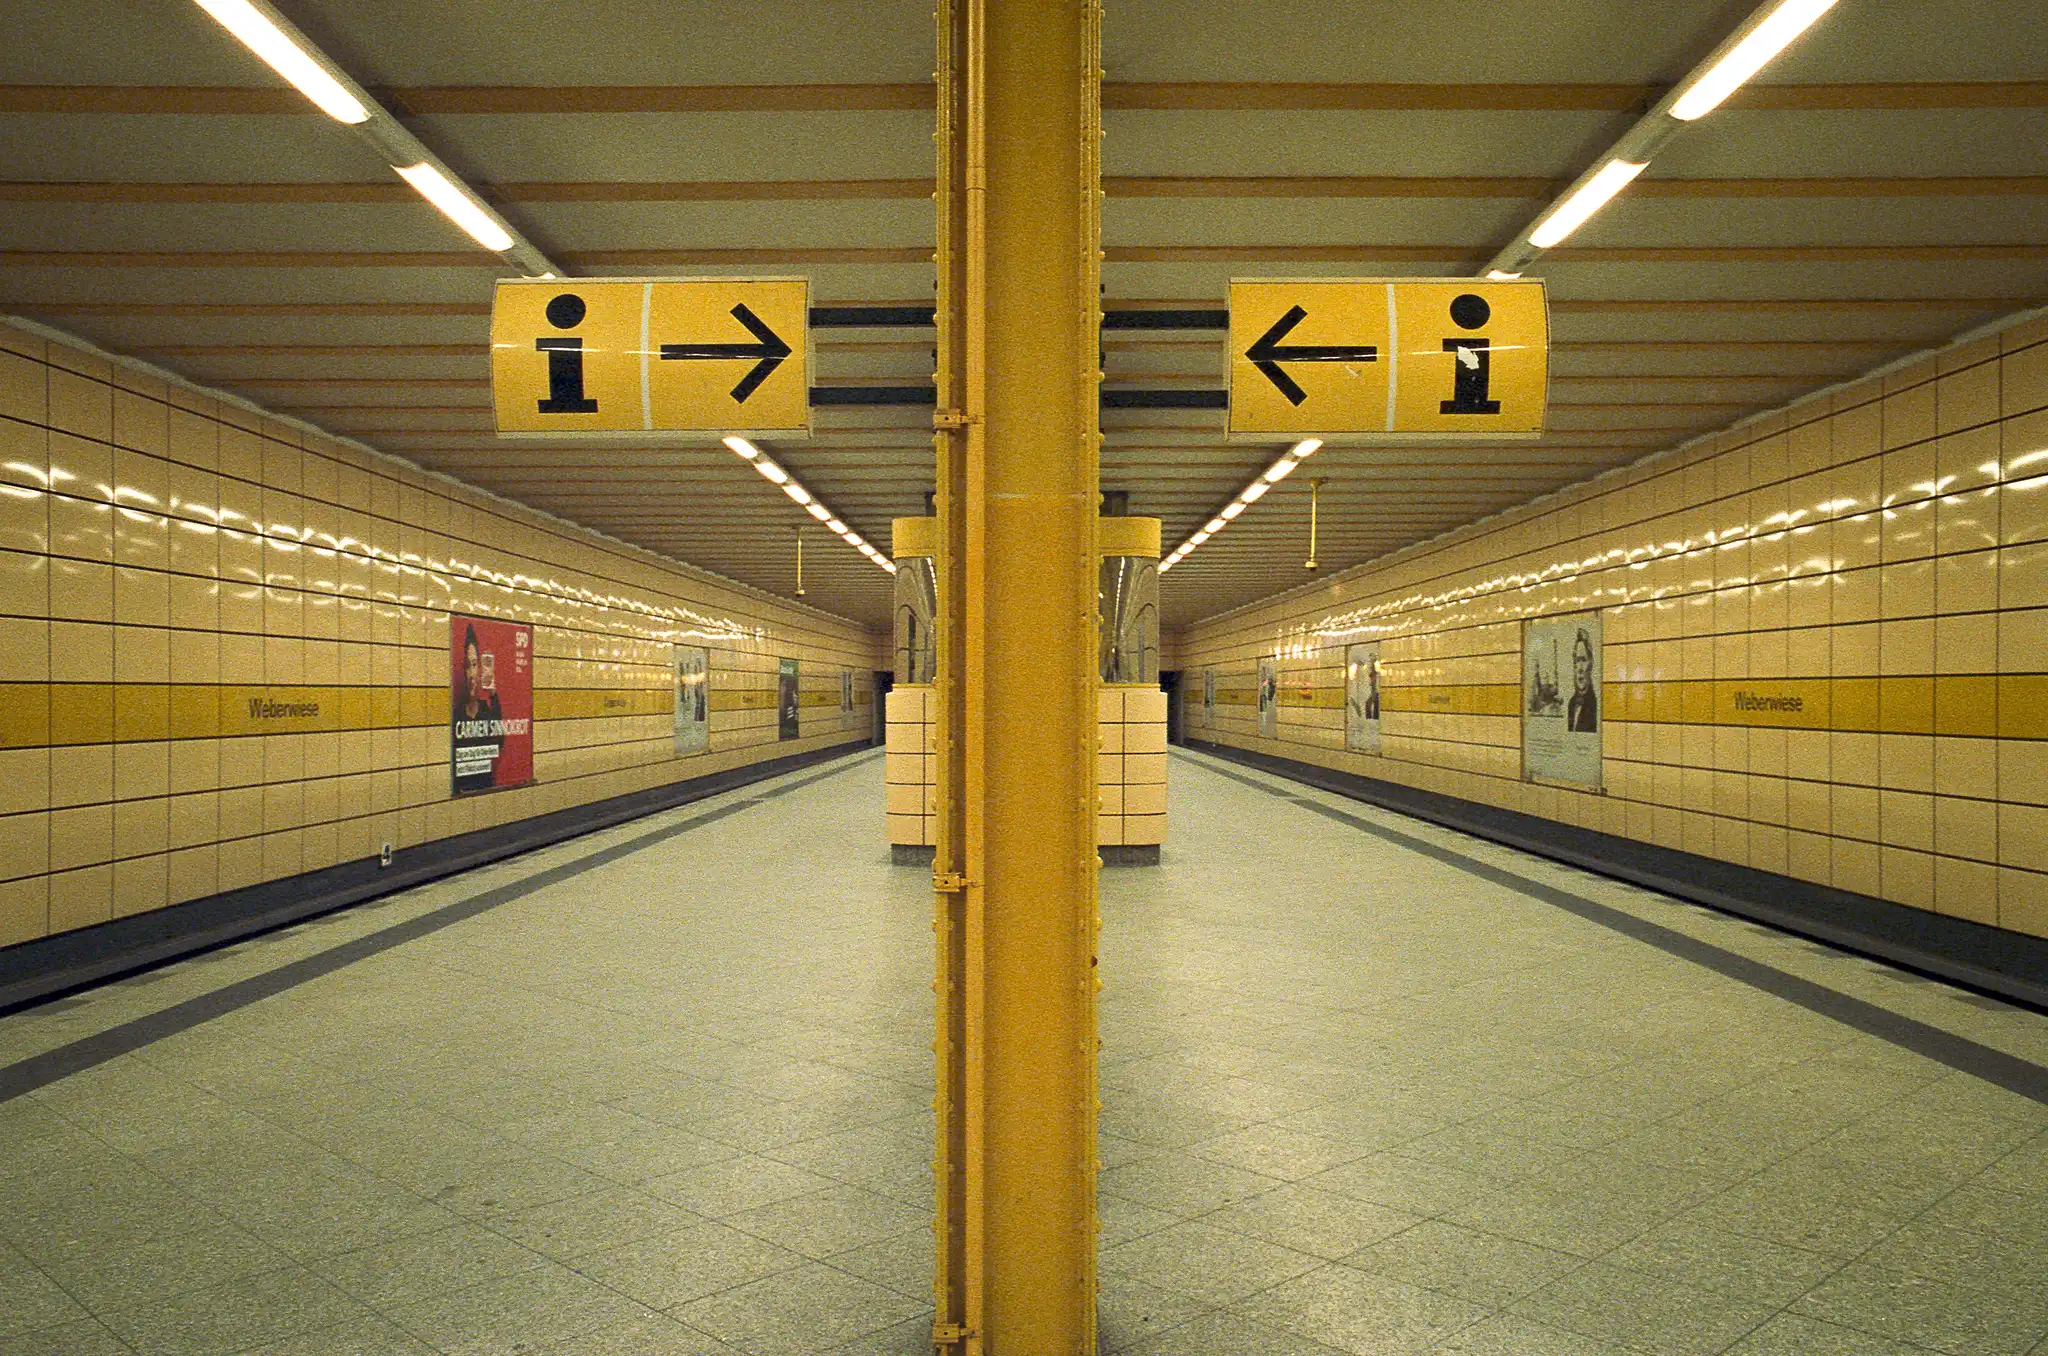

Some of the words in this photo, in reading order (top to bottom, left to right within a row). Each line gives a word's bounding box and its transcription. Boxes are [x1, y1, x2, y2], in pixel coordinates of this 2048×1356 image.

[515, 631, 528, 648] SPD
[248, 698, 319, 719] Weberwiese
[1734, 691, 1803, 713] Weberwiese
[455, 720, 489, 739] CARMEN
